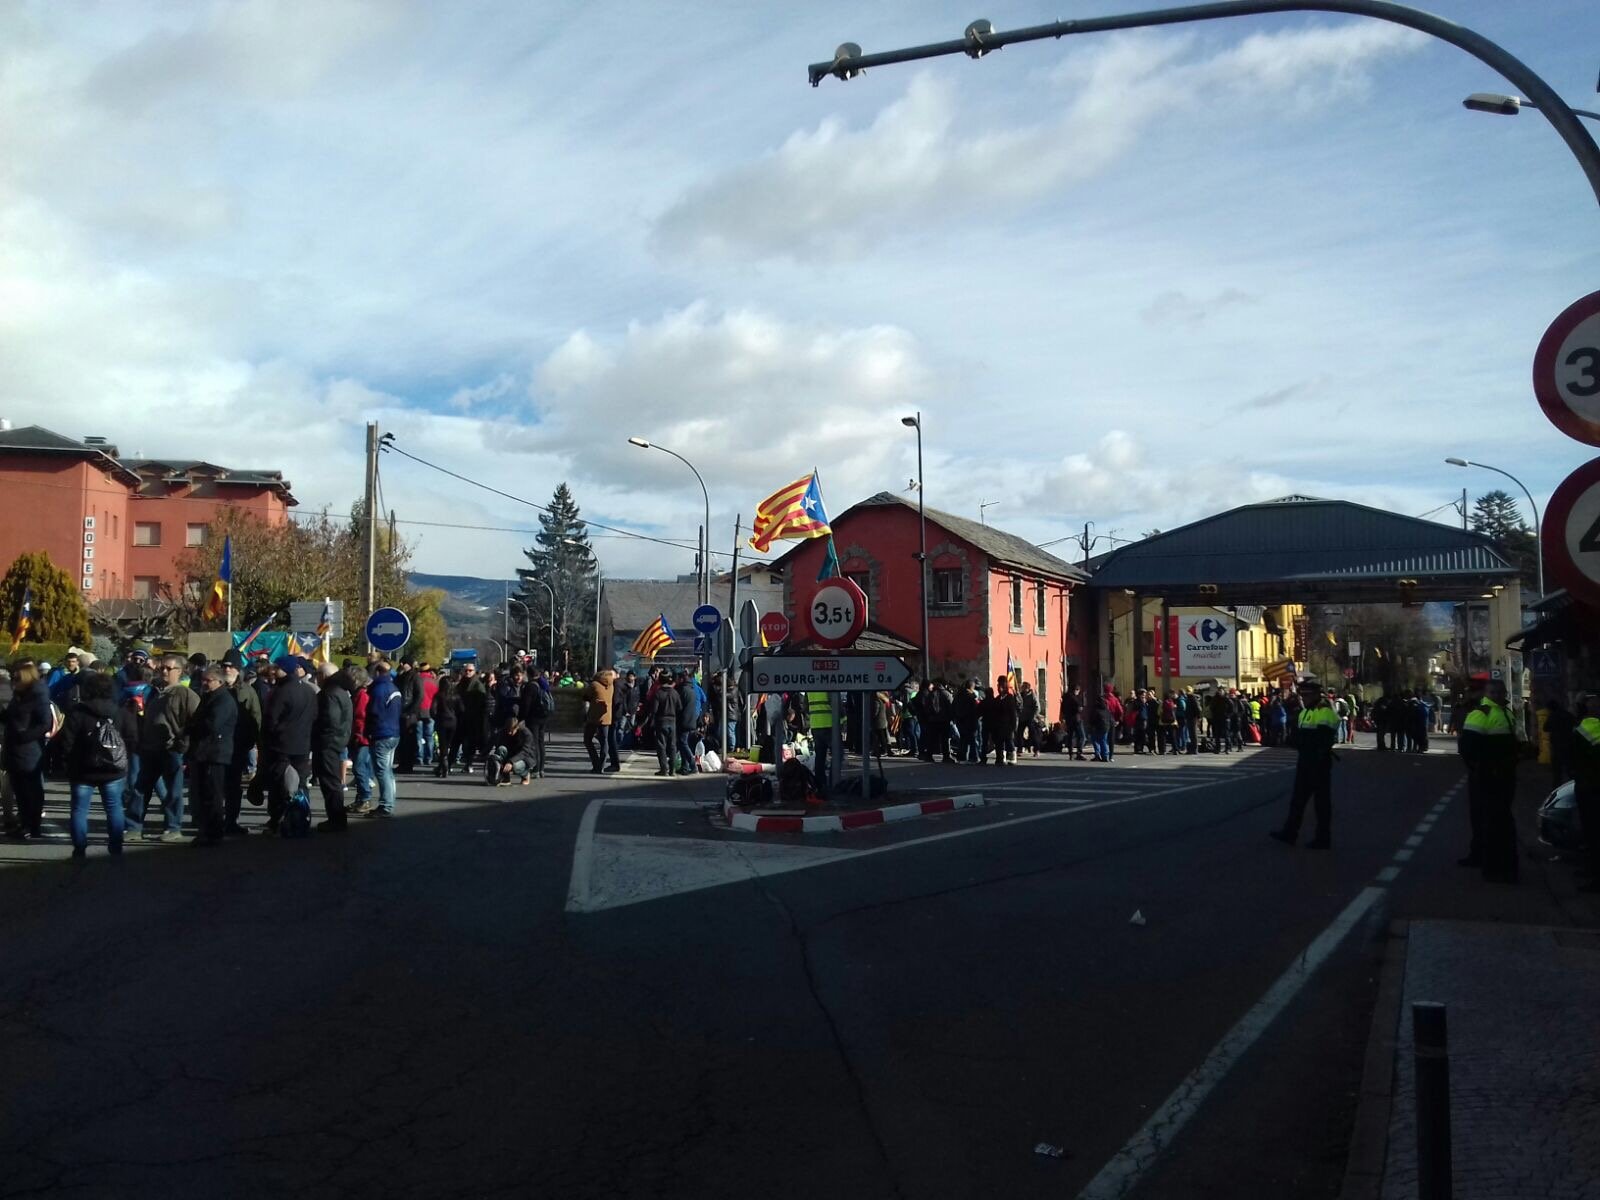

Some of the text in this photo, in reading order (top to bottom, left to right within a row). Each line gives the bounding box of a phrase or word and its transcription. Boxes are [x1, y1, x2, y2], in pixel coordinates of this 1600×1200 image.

[84, 518, 93, 588] HOTEL
[761, 623, 787, 631] STOP
[813, 661, 838, 670] N-152
[774, 673, 870, 685] BOURG-MADAME
